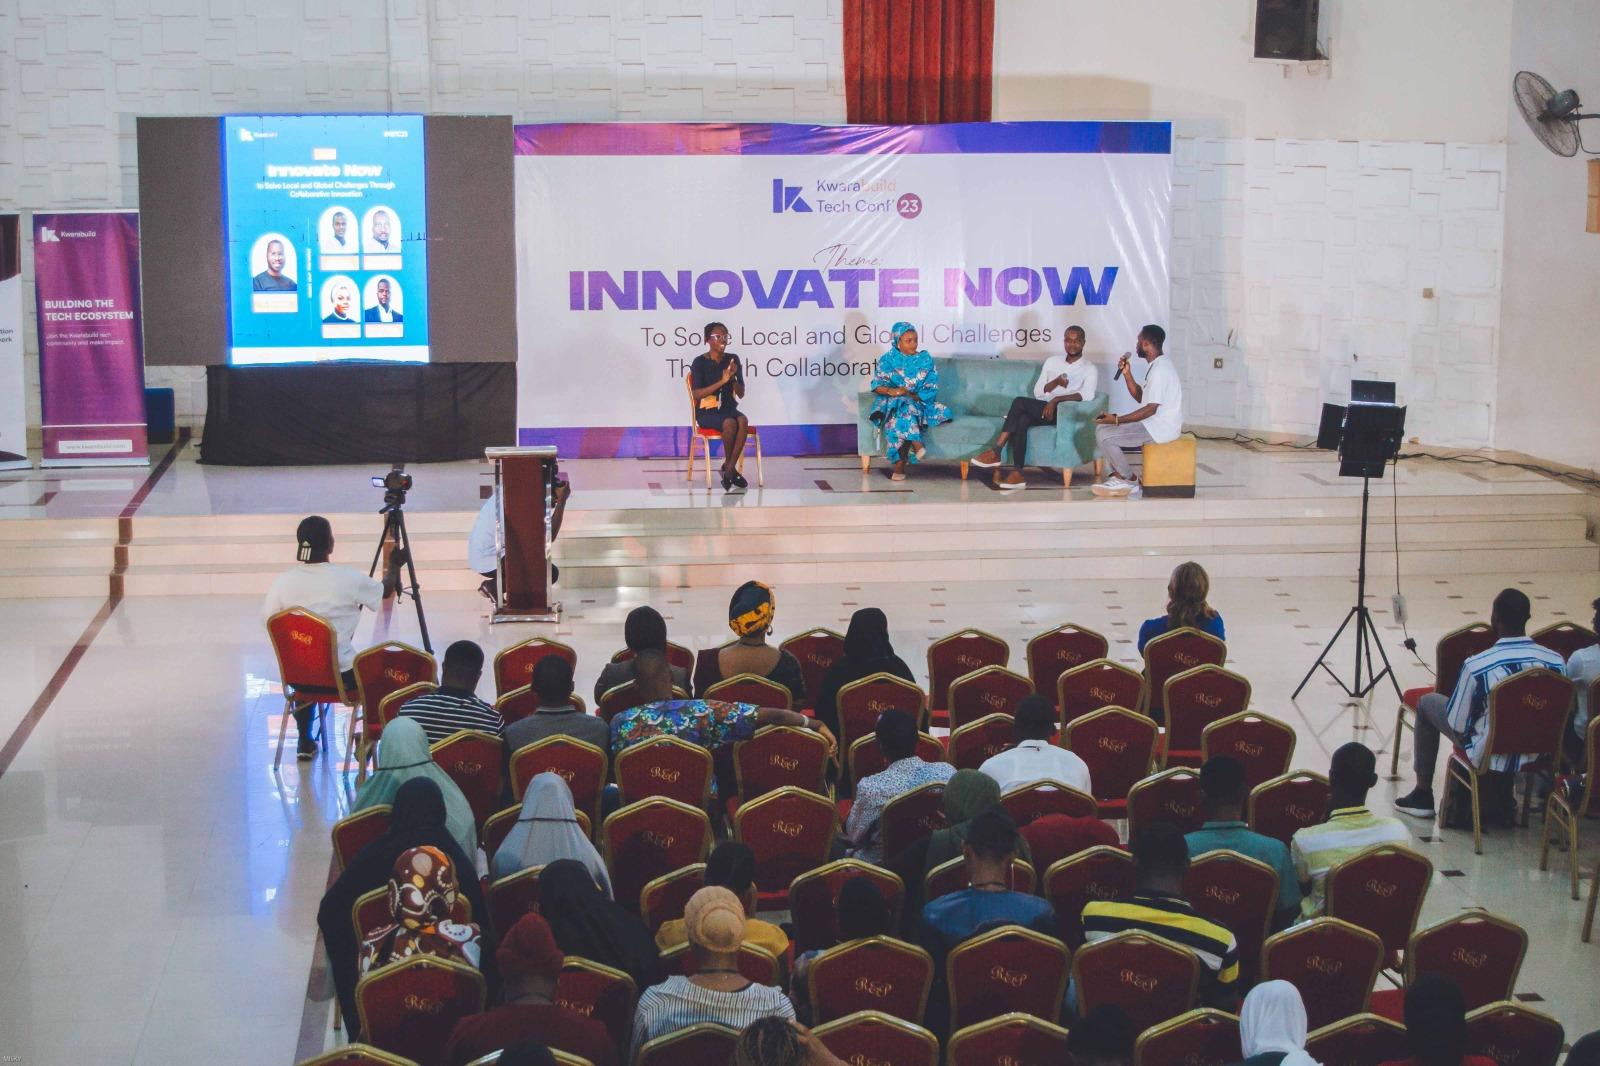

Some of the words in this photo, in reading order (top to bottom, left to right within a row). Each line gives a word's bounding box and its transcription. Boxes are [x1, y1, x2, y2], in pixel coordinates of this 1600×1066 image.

[267, 164, 340, 177] Innovate
[343, 164, 382, 177] Now
[817, 180, 896, 192] Kwarabuild
[817, 200, 849, 213] Tech
[900, 199, 919, 213] 23
[569, 268, 919, 311] INNOVATE
[944, 266, 1119, 308] NOW
[45, 300, 93, 309] BUILDING
[95, 299, 114, 308] THE
[45, 312, 72, 321] TECH
[75, 311, 134, 320] ECOSYSTEM
[641, 327, 666, 347] To
[741, 325, 797, 346] Local
[806, 324, 846, 345] and
[855, 324, 924, 345] Glol
[933, 322, 1052, 348] Challenges
[766, 357, 879, 377] Collaborat
